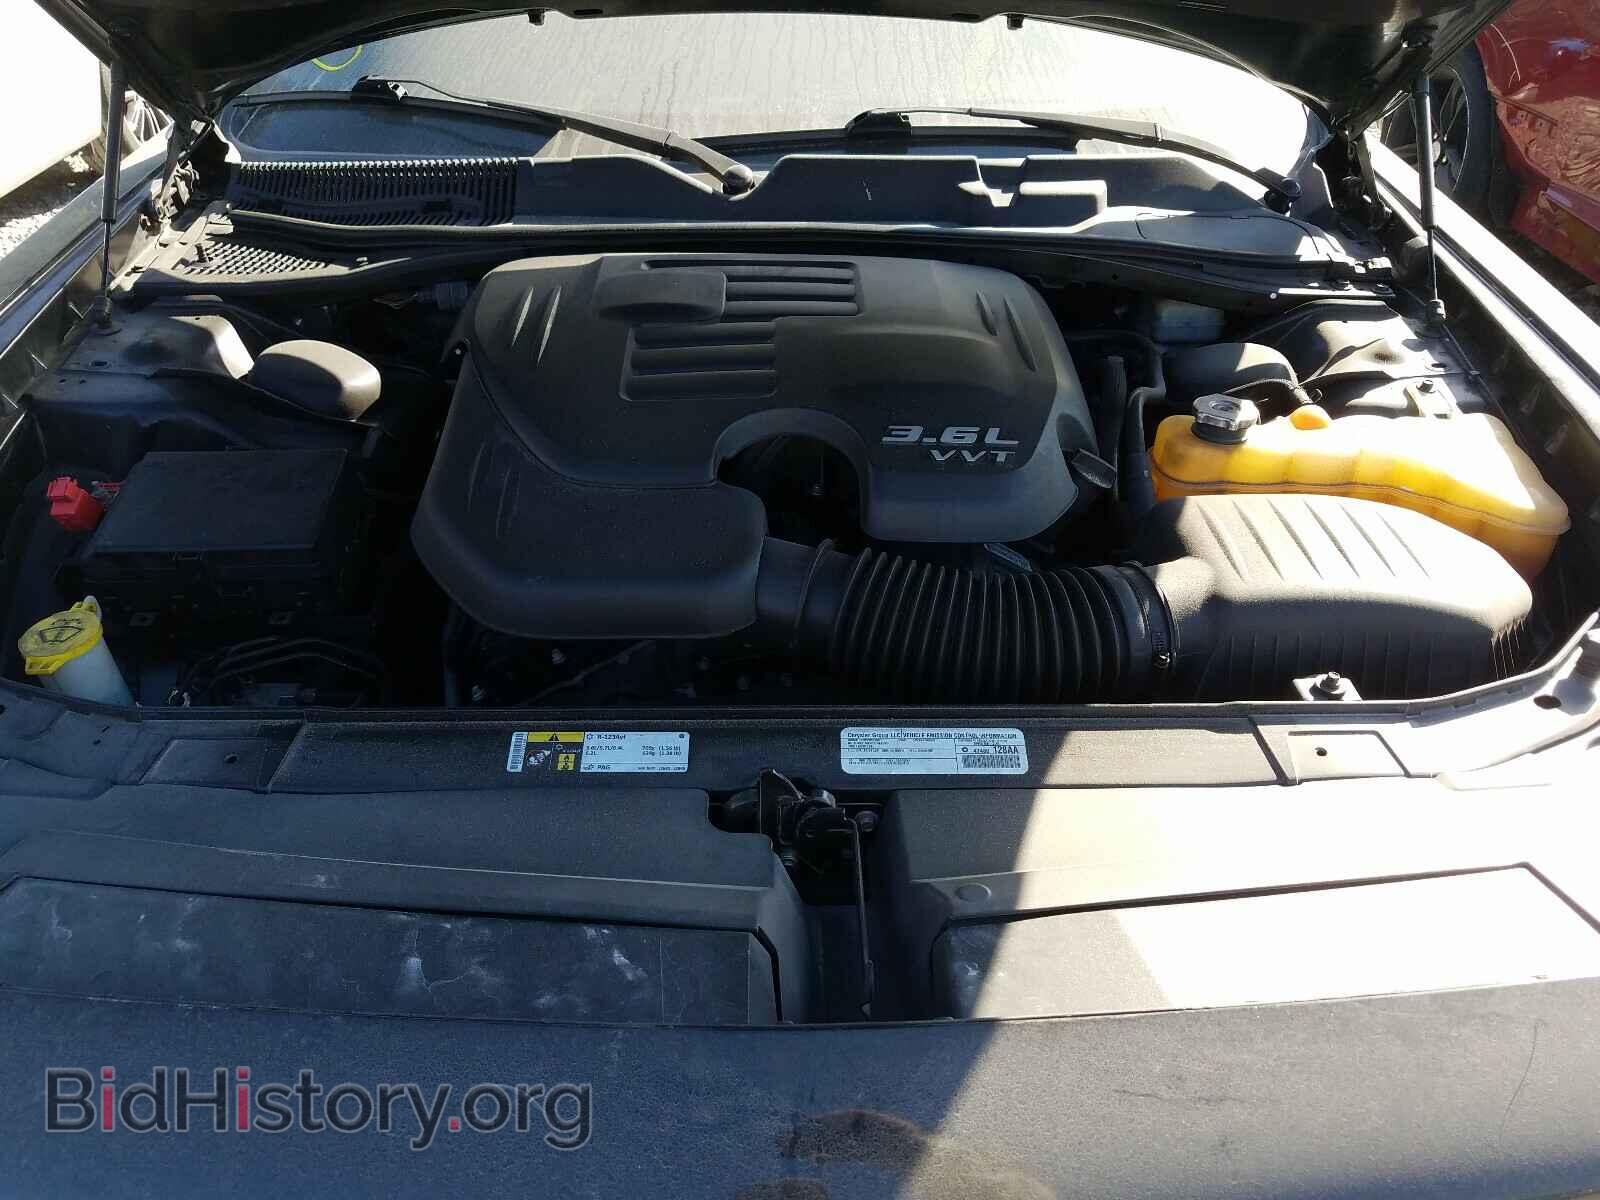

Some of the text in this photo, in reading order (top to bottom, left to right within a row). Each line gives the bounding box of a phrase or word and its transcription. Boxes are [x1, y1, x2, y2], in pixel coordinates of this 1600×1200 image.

[881, 425, 1019, 444] 3.6L
[929, 449, 1016, 463] VVT
[993, 745, 1019, 754] 128AA
